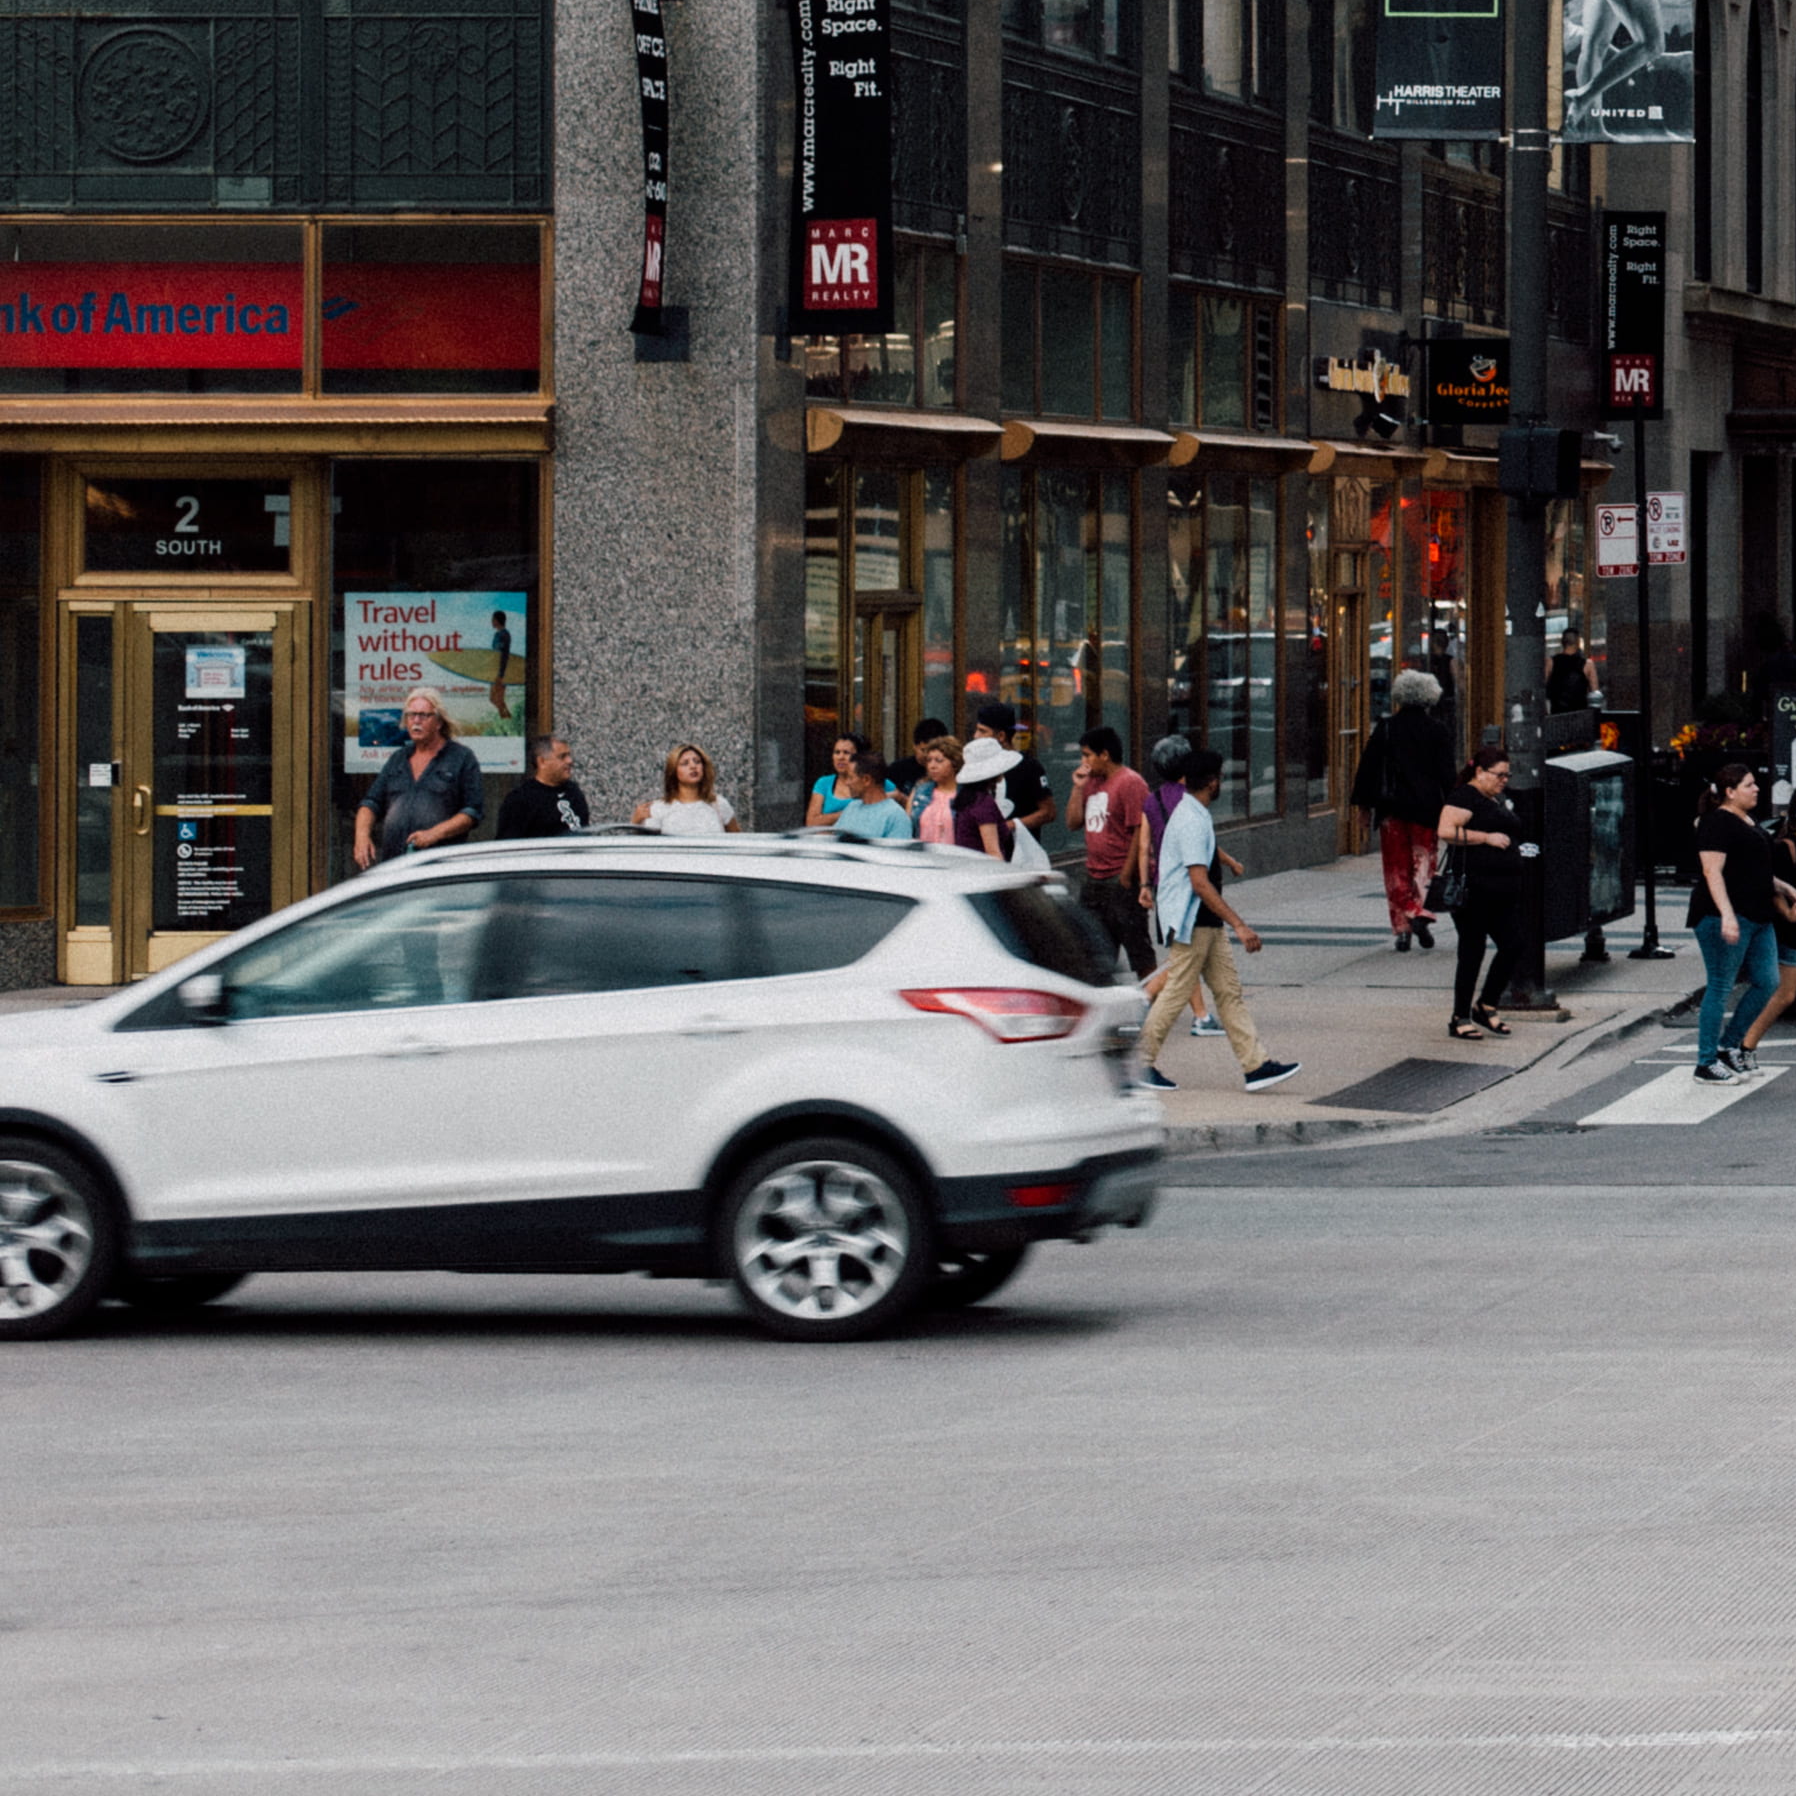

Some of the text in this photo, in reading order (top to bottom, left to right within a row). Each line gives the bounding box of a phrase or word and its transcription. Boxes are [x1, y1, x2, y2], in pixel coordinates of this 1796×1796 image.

[821, 18, 883, 37] Space.
[829, 58, 876, 79] Right
[854, 81, 883, 98] Fit.
[1394, 85, 1501, 99] HARRIS THEATER
[1590, 109, 1646, 118] UNITED
[811, 226, 870, 239] MARC
[1627, 225, 1657, 235] Right
[1622, 237, 1661, 248] Space.
[811, 243, 870, 285] MR
[1626, 262, 1657, 273] Right
[811, 289, 871, 302] REALTY
[1608, 224, 1618, 350] www.marcrealty.com
[51, 292, 97, 335] of
[102, 292, 290, 335] America
[1615, 368, 1650, 392] MR
[1436, 383, 1486, 397] Gloria
[174, 496, 200, 533] 2
[155, 539, 222, 555] SOUTH
[356, 599, 436, 624] Travel
[358, 628, 464, 652] without
[359, 657, 423, 681] rules
